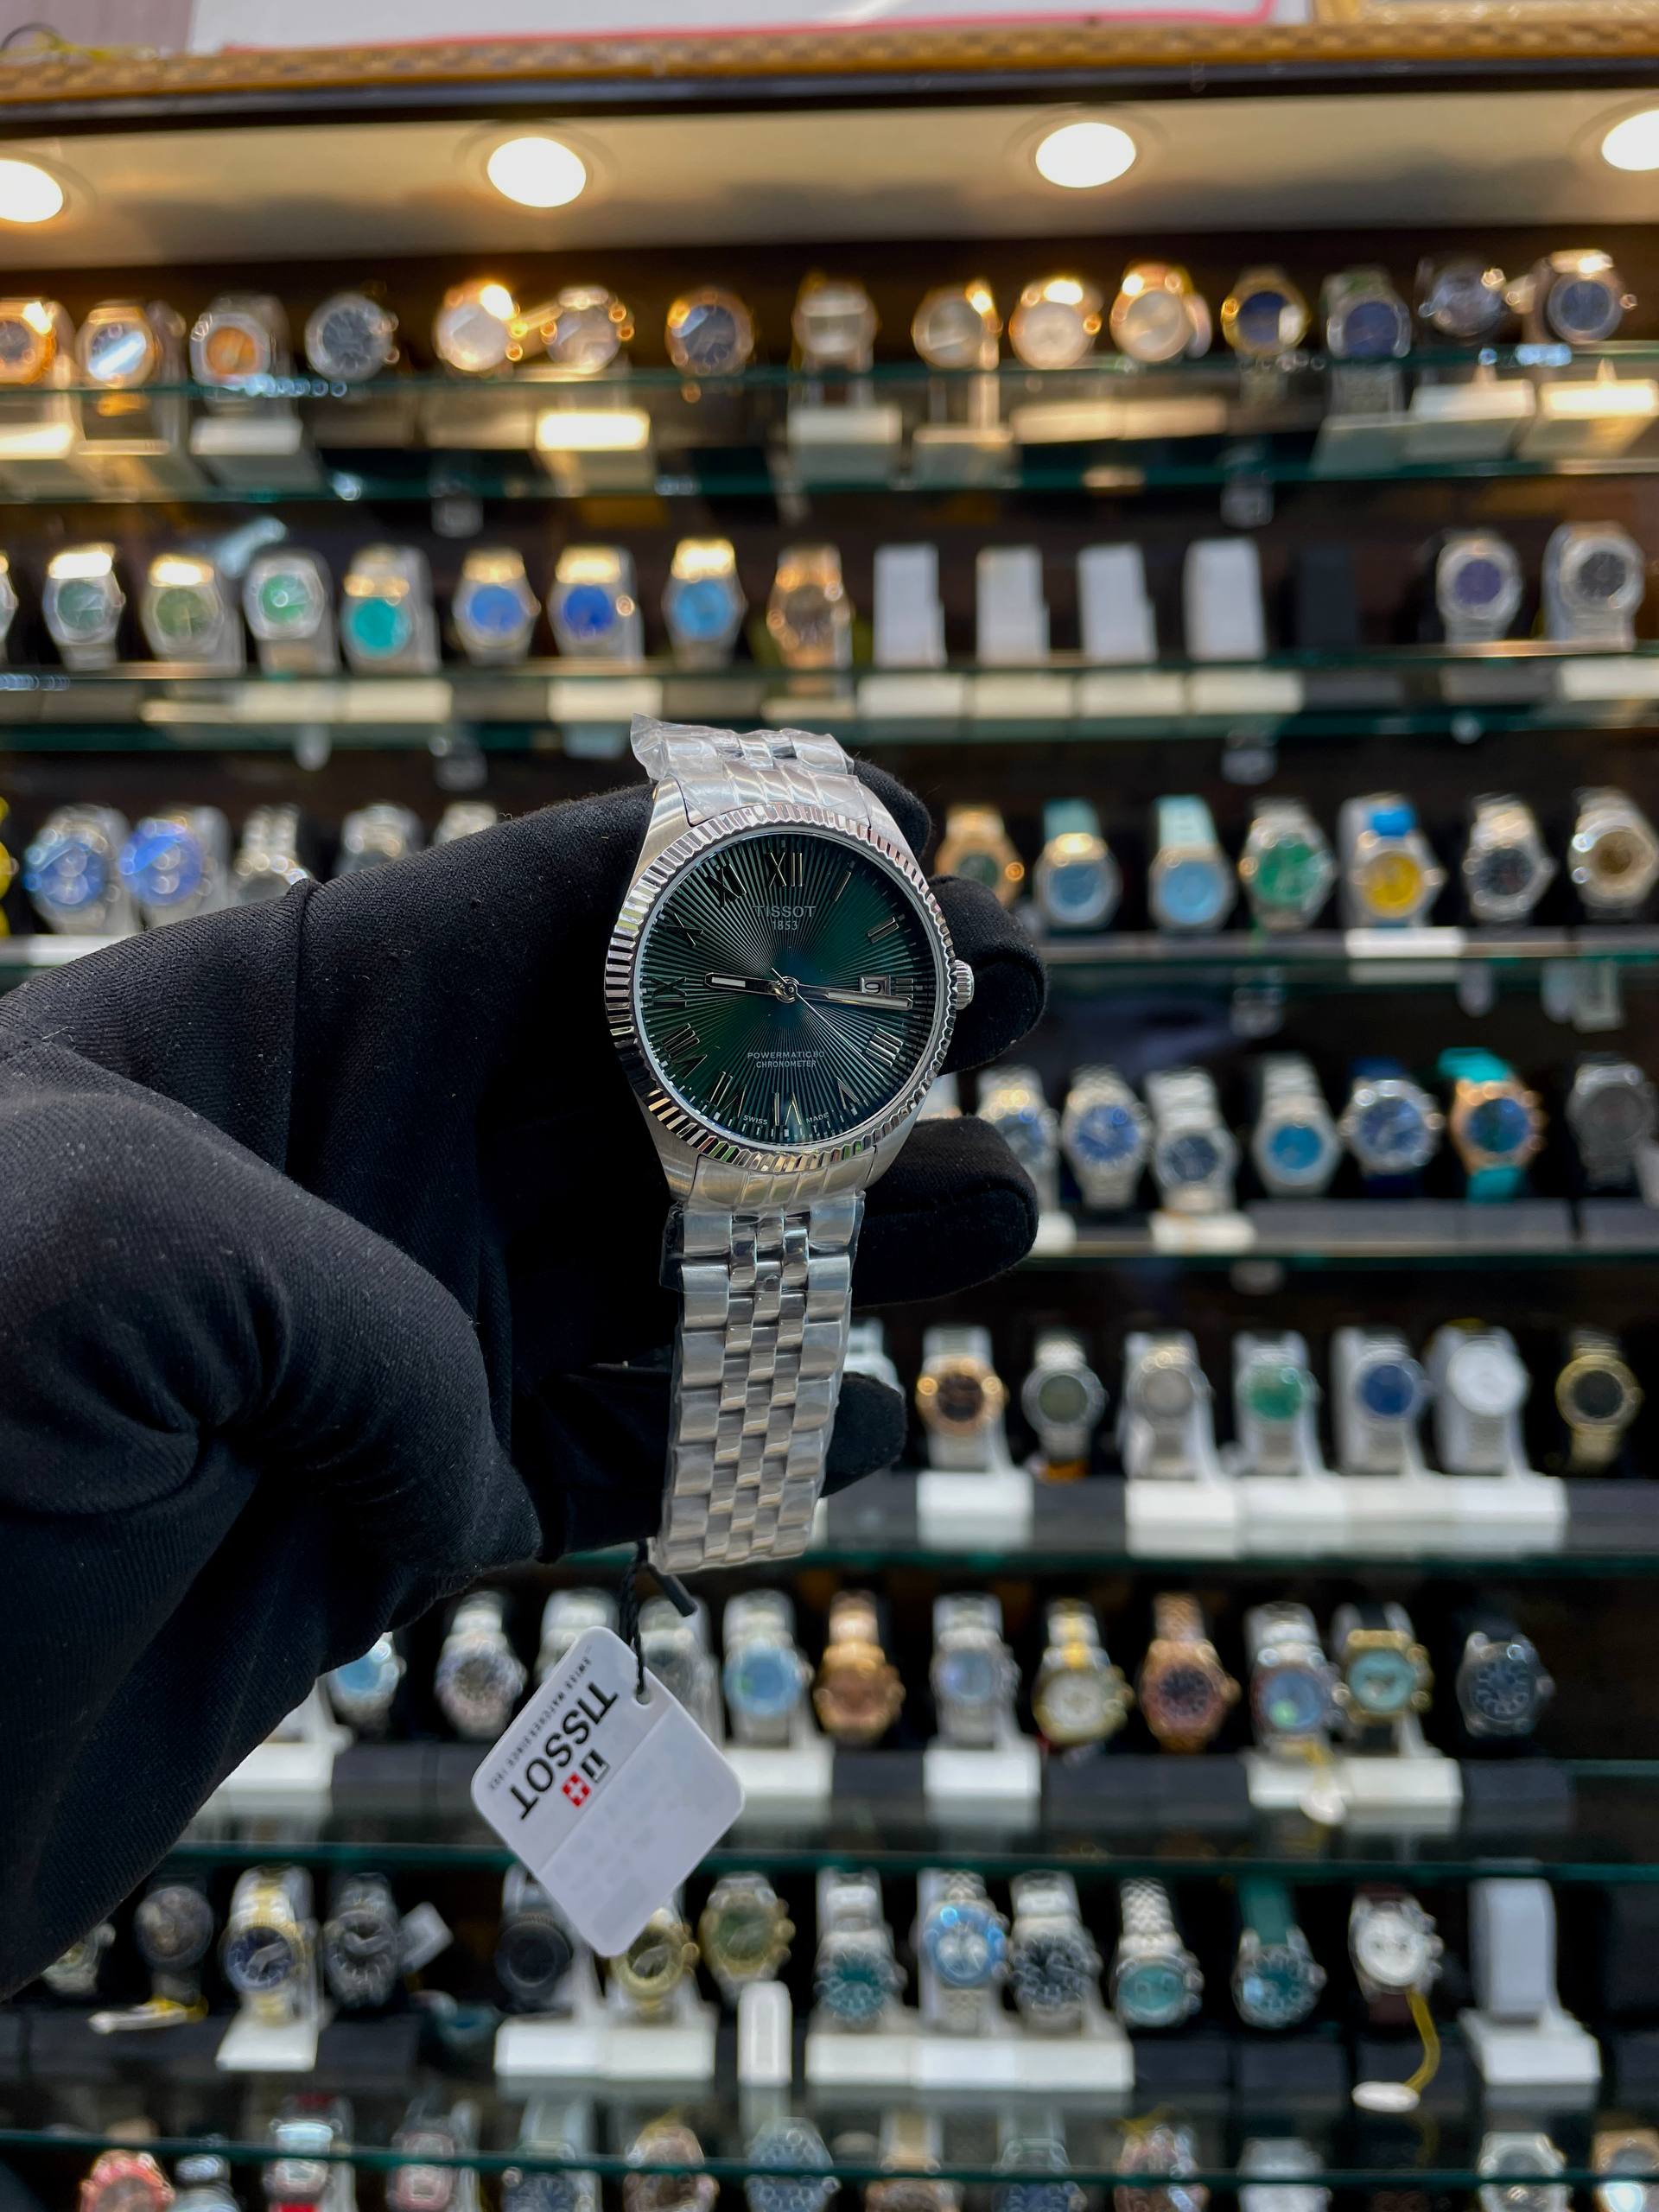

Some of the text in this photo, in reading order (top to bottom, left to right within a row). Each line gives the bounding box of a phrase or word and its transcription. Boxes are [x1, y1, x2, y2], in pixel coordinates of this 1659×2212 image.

[752, 906, 817, 918] TISSOT
[772, 920, 798, 931] 1853
[864, 982, 882, 995] 9
[755, 1060, 817, 1069] CHRONOMETER
[743, 1111, 830, 1125] SWISS MADE
[509, 1681, 620, 1821] TISSOT
